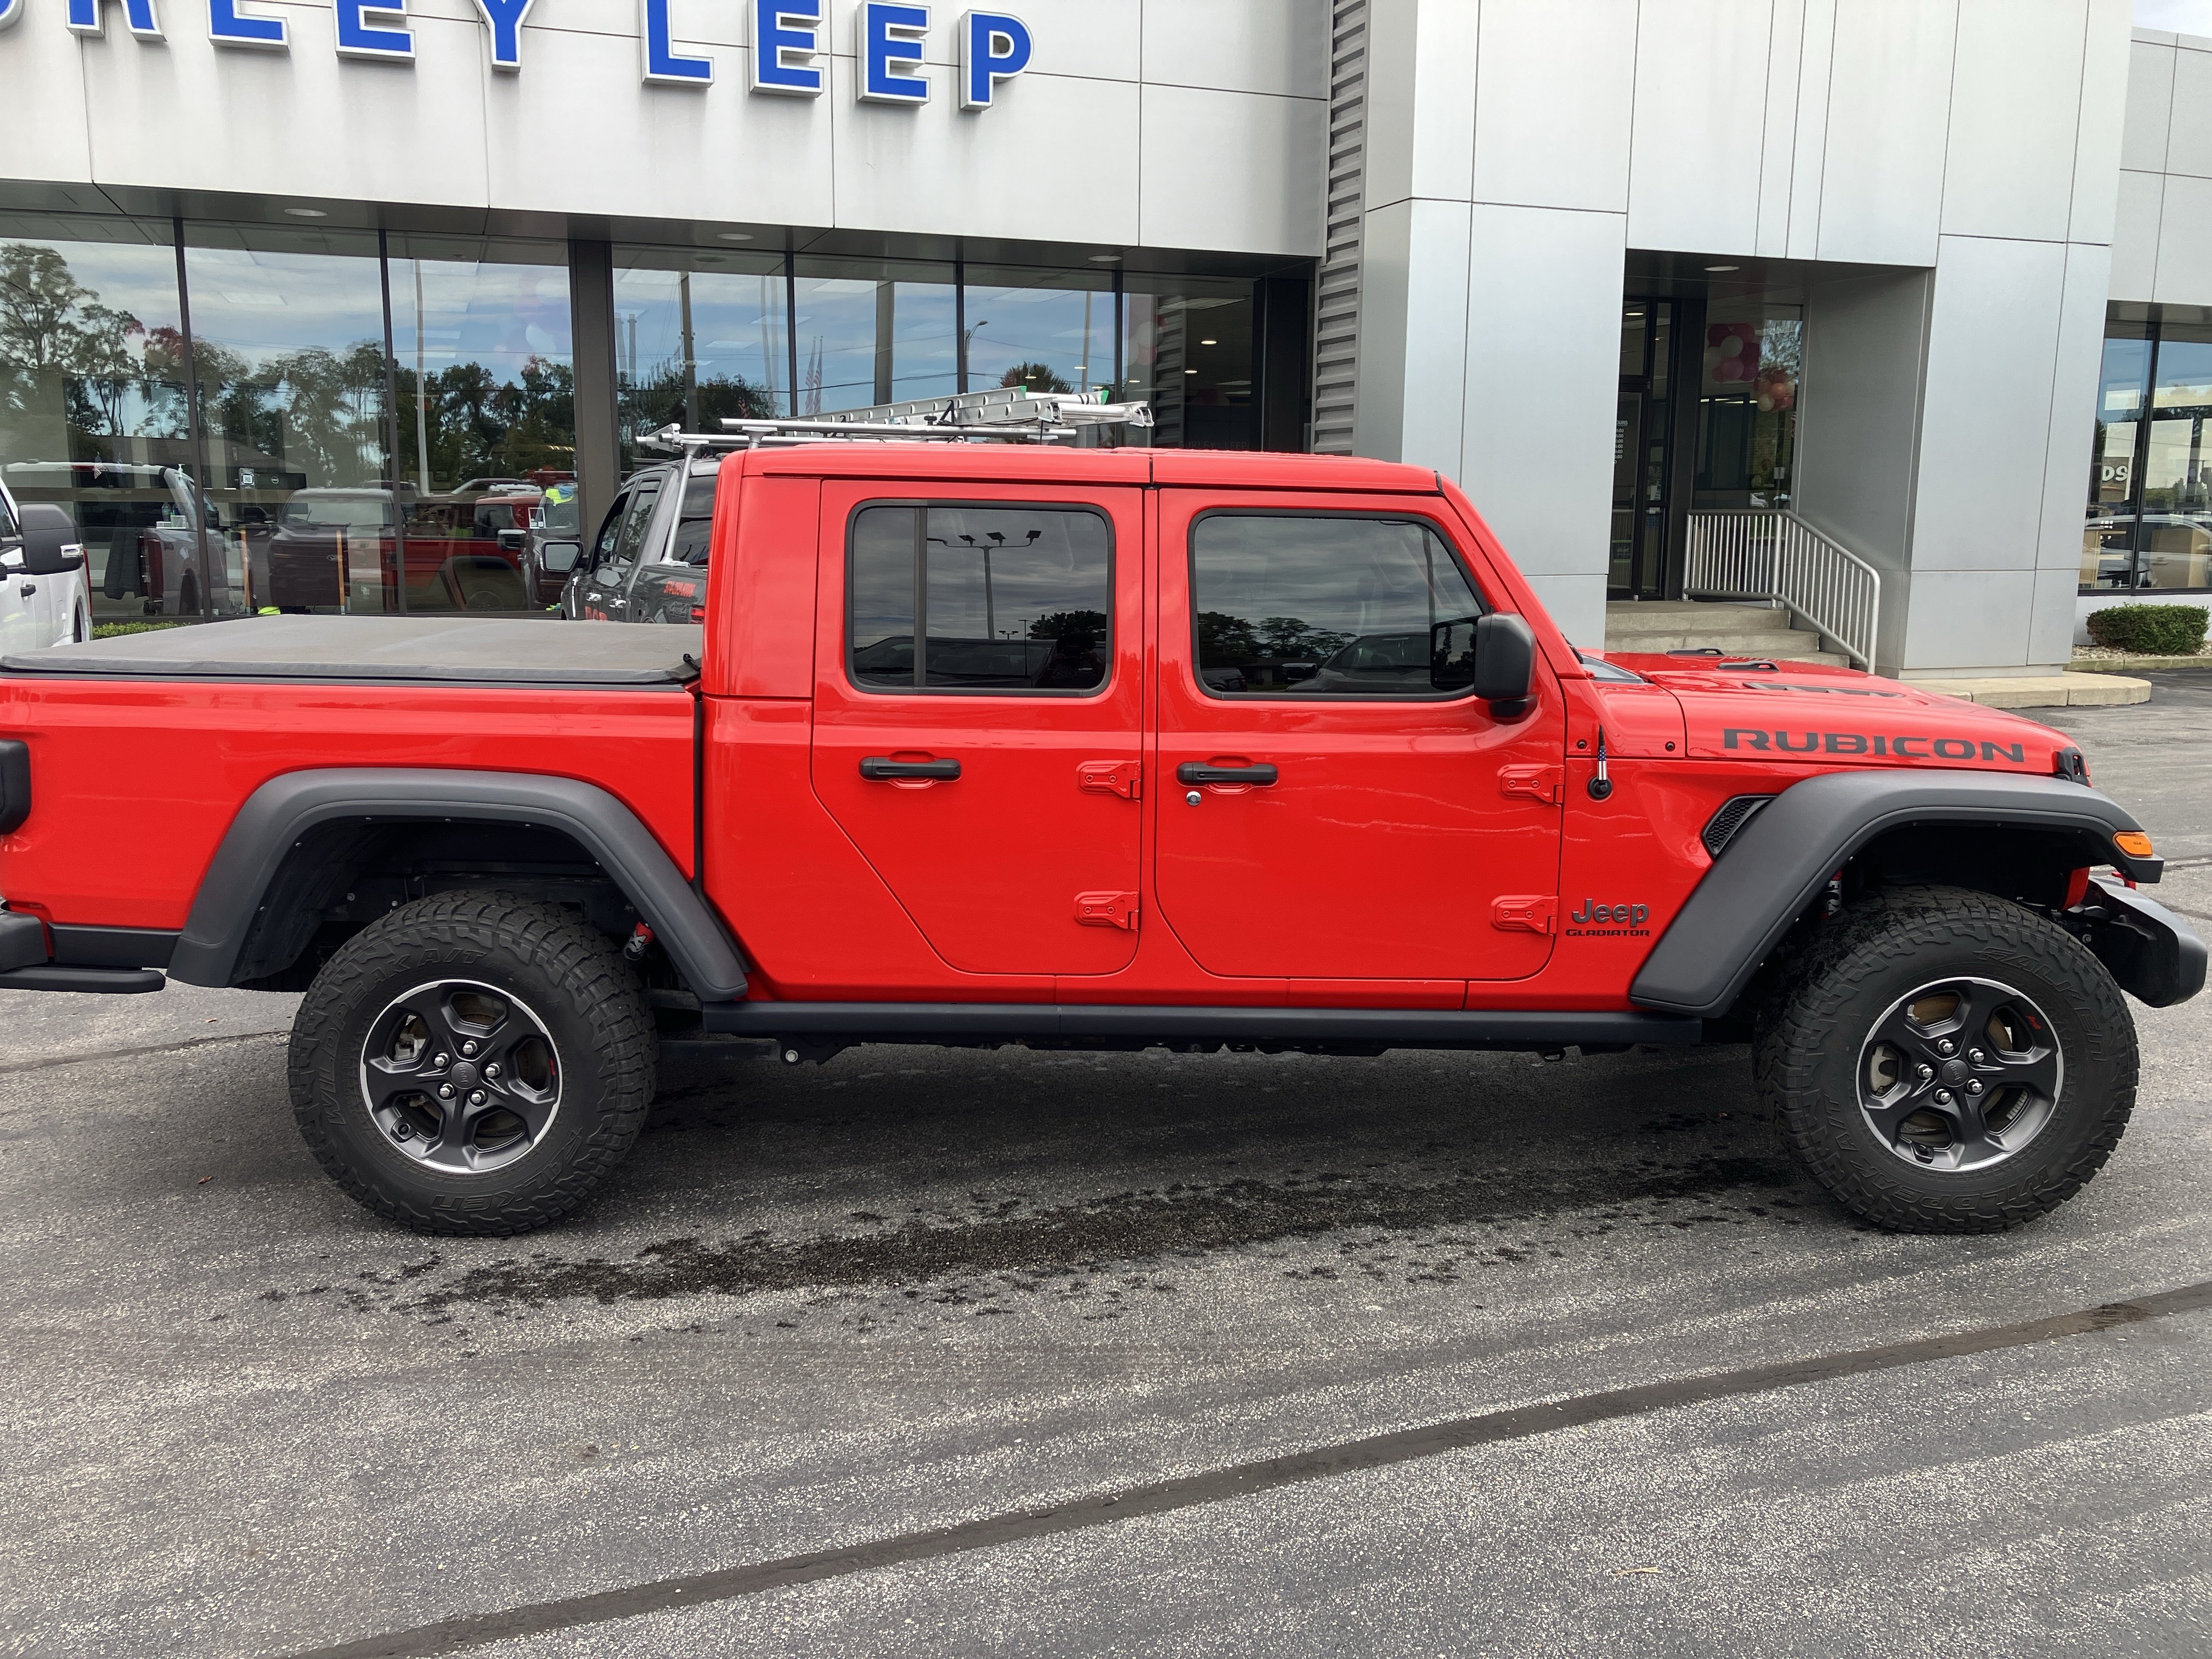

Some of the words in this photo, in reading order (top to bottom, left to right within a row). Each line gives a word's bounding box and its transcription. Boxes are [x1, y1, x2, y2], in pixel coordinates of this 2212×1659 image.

[640, 0, 1035, 111] LEEP
[1723, 728, 2026, 763] RUBICON
[1572, 898, 1649, 927] Jeep
[1565, 929, 1650, 937] GLADIATOR
